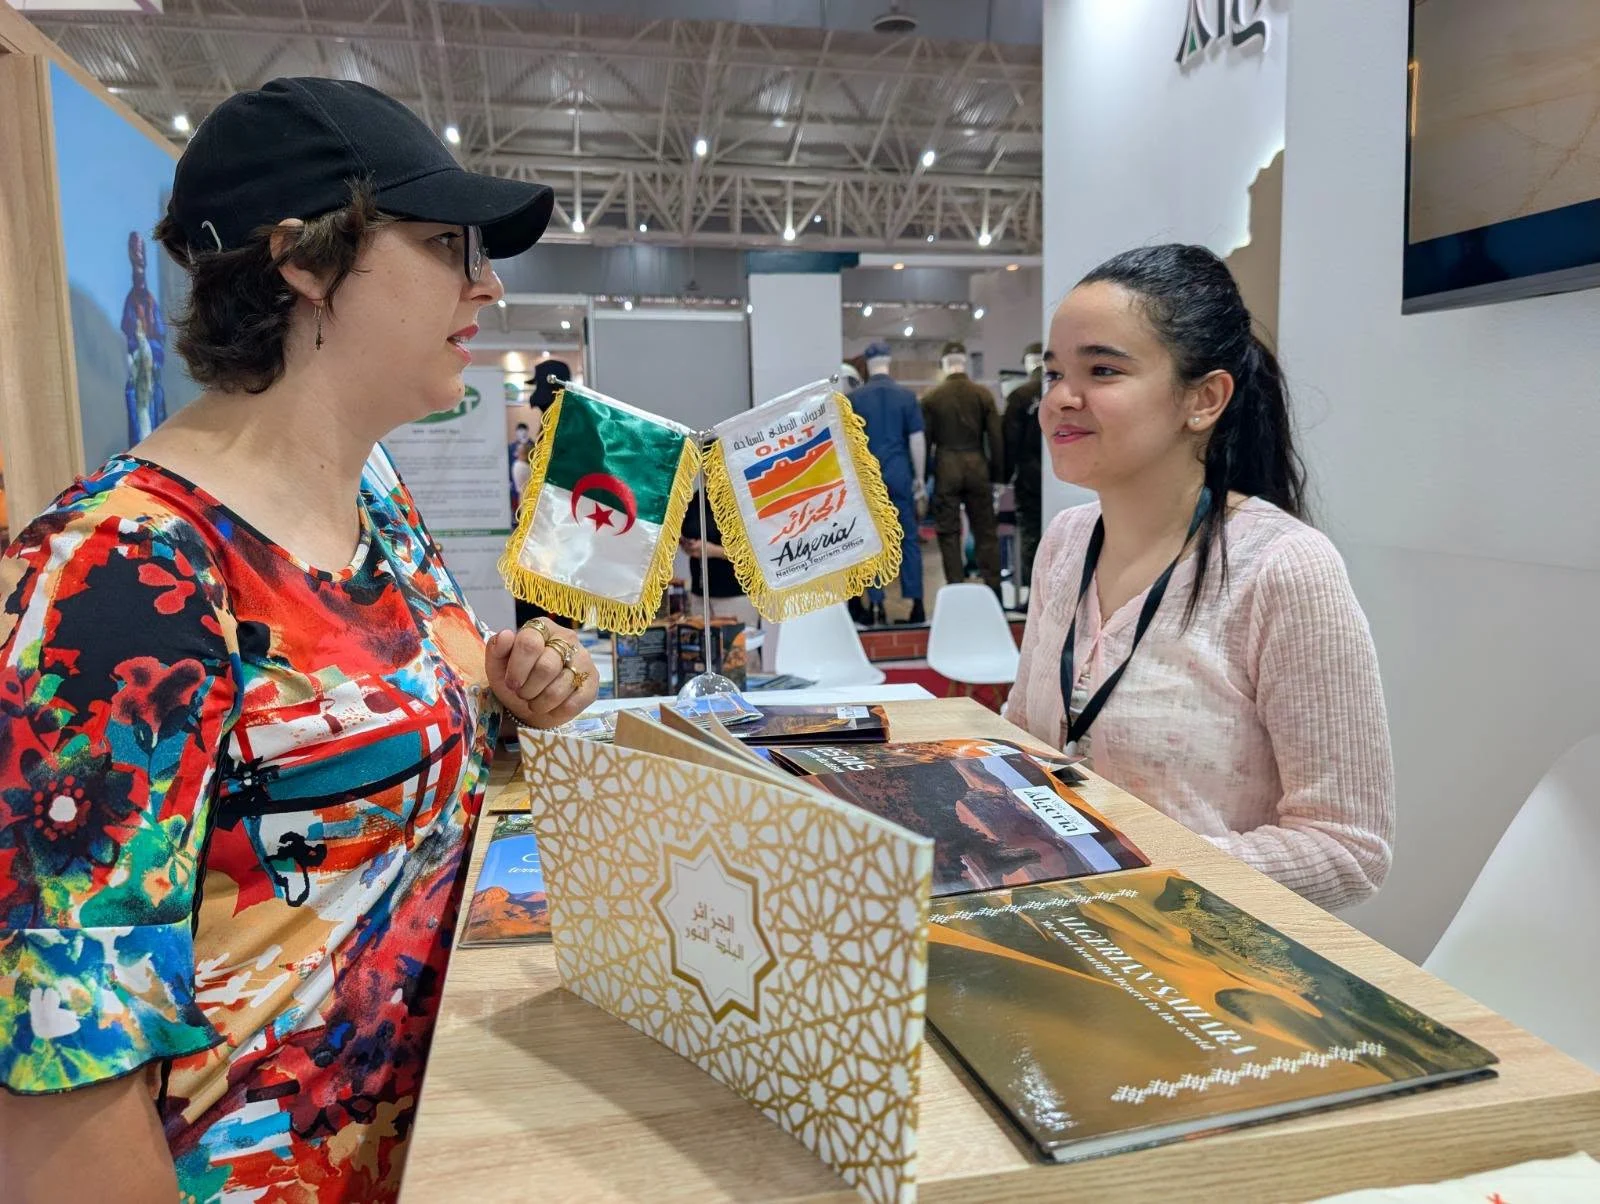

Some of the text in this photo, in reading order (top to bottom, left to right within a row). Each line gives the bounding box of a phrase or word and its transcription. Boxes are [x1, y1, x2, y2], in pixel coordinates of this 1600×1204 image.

[767, 487, 848, 546] الجزائر
[769, 516, 857, 571] Algeria
[775, 538, 864, 578] National Tourism Office
[1023, 790, 1079, 832] Algeria
[1158, 1012, 1180, 1025] the
[1176, 1026, 1217, 1050] world
